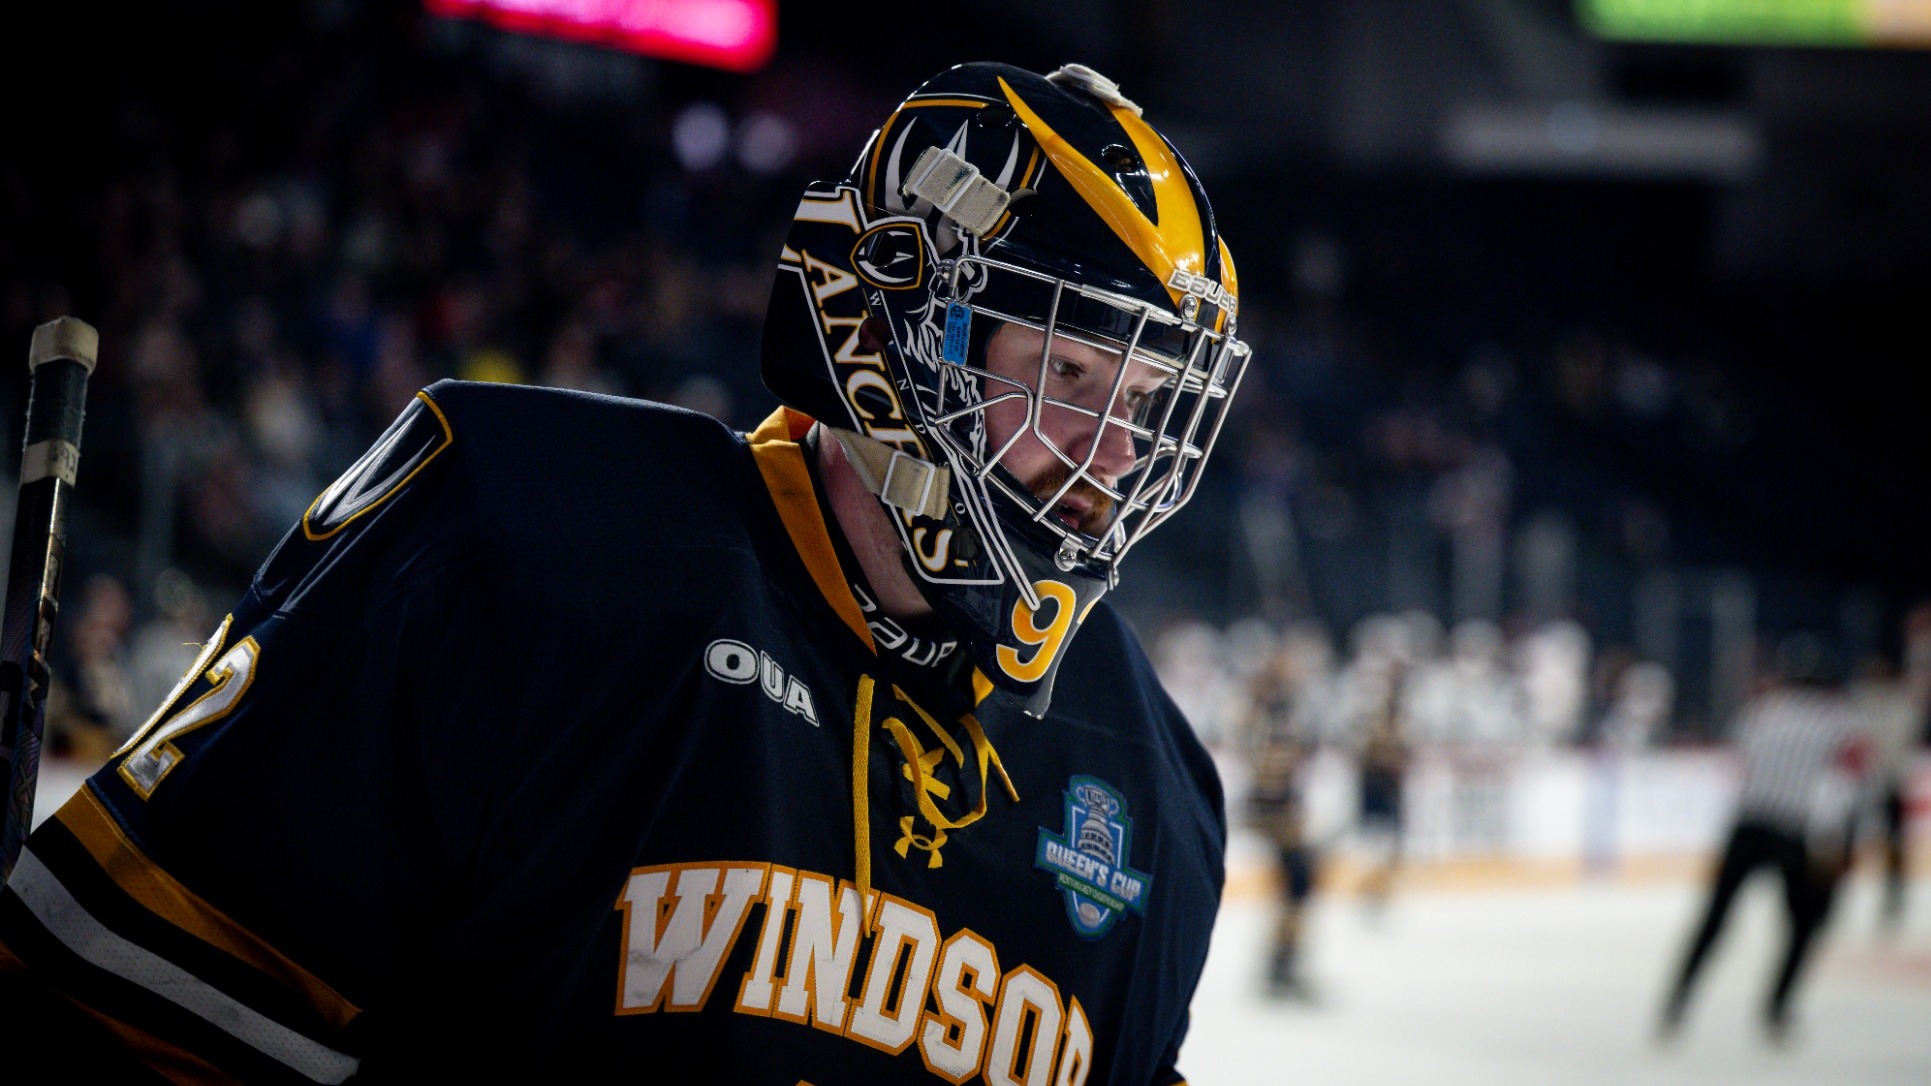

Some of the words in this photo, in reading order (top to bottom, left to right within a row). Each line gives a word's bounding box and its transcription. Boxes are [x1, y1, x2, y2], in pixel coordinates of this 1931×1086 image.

[1167, 269, 1237, 314] BAUER
[780, 187, 970, 572] LANCES
[704, 639, 820, 727] OUA
[1045, 840, 1109, 887] QUEEN'S
[1110, 871, 1142, 901] CUP
